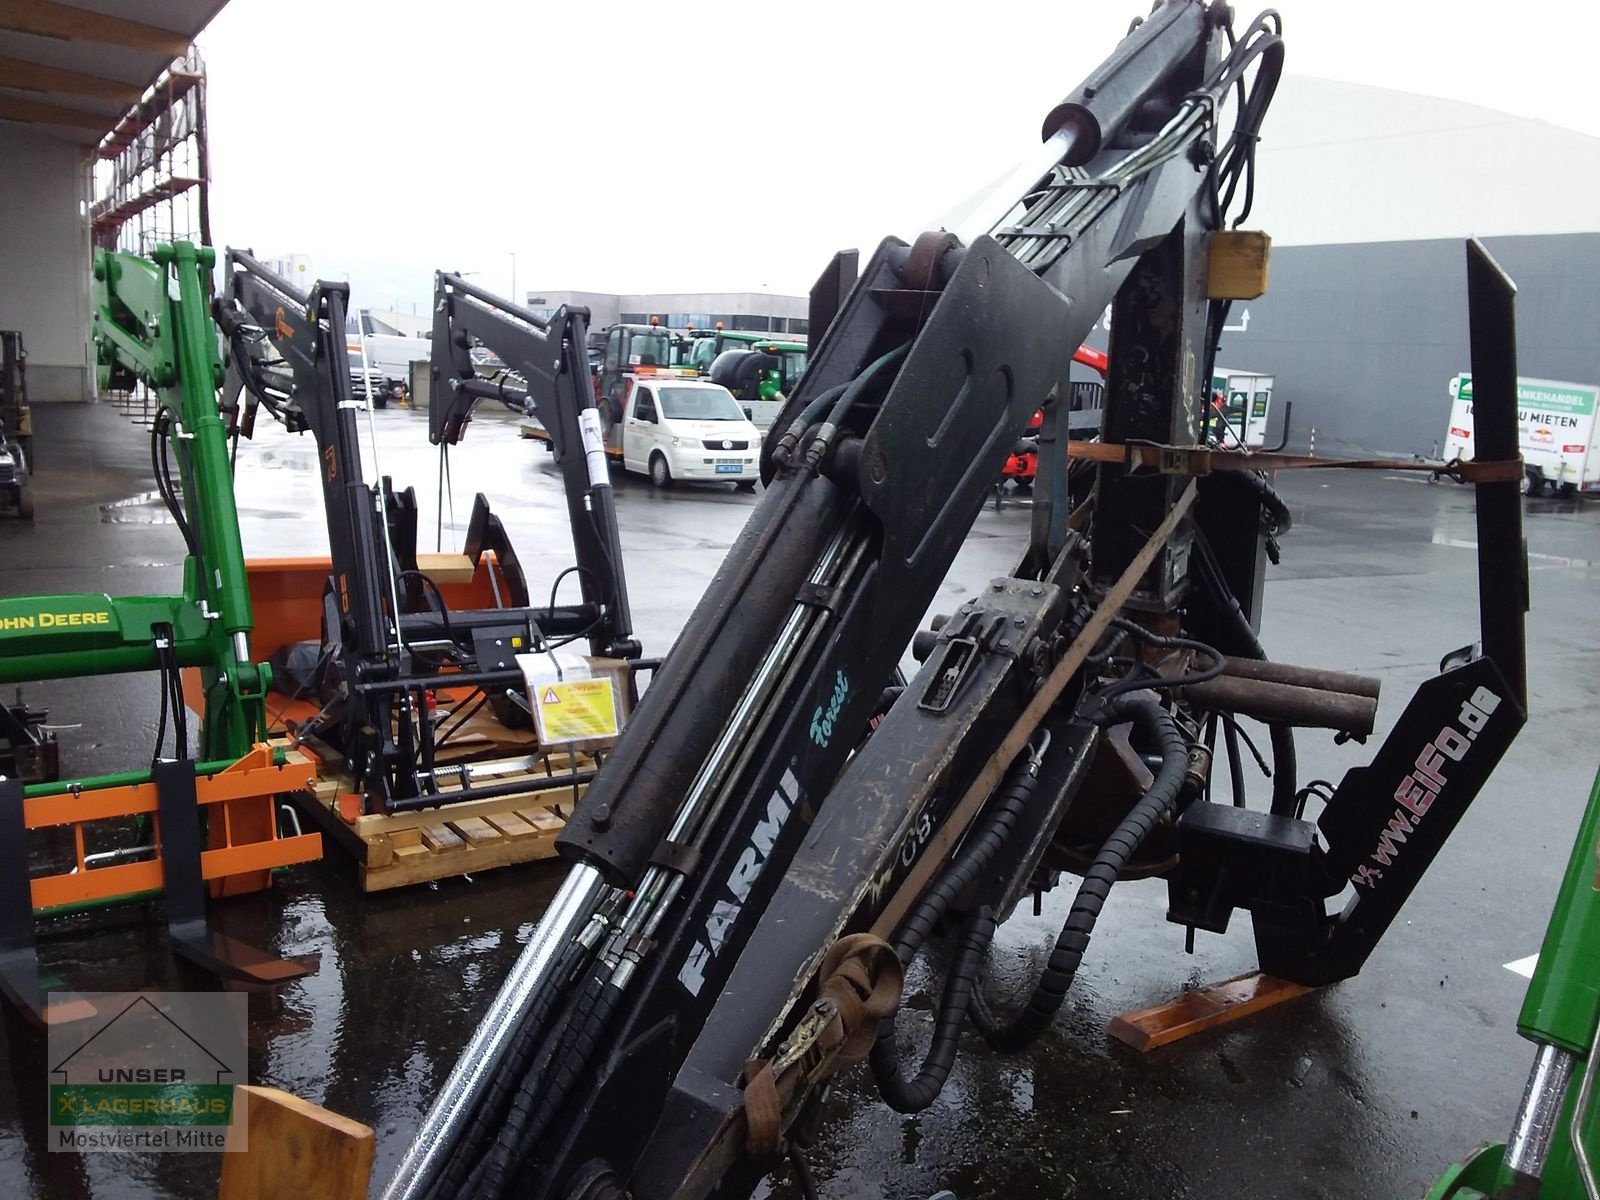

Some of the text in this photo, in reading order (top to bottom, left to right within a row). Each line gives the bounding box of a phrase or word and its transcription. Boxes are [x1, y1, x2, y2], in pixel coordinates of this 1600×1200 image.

[1530, 413, 1578, 428] MIETEN
[39, 612, 110, 628] DEERE
[677, 767, 800, 999] FARMI
